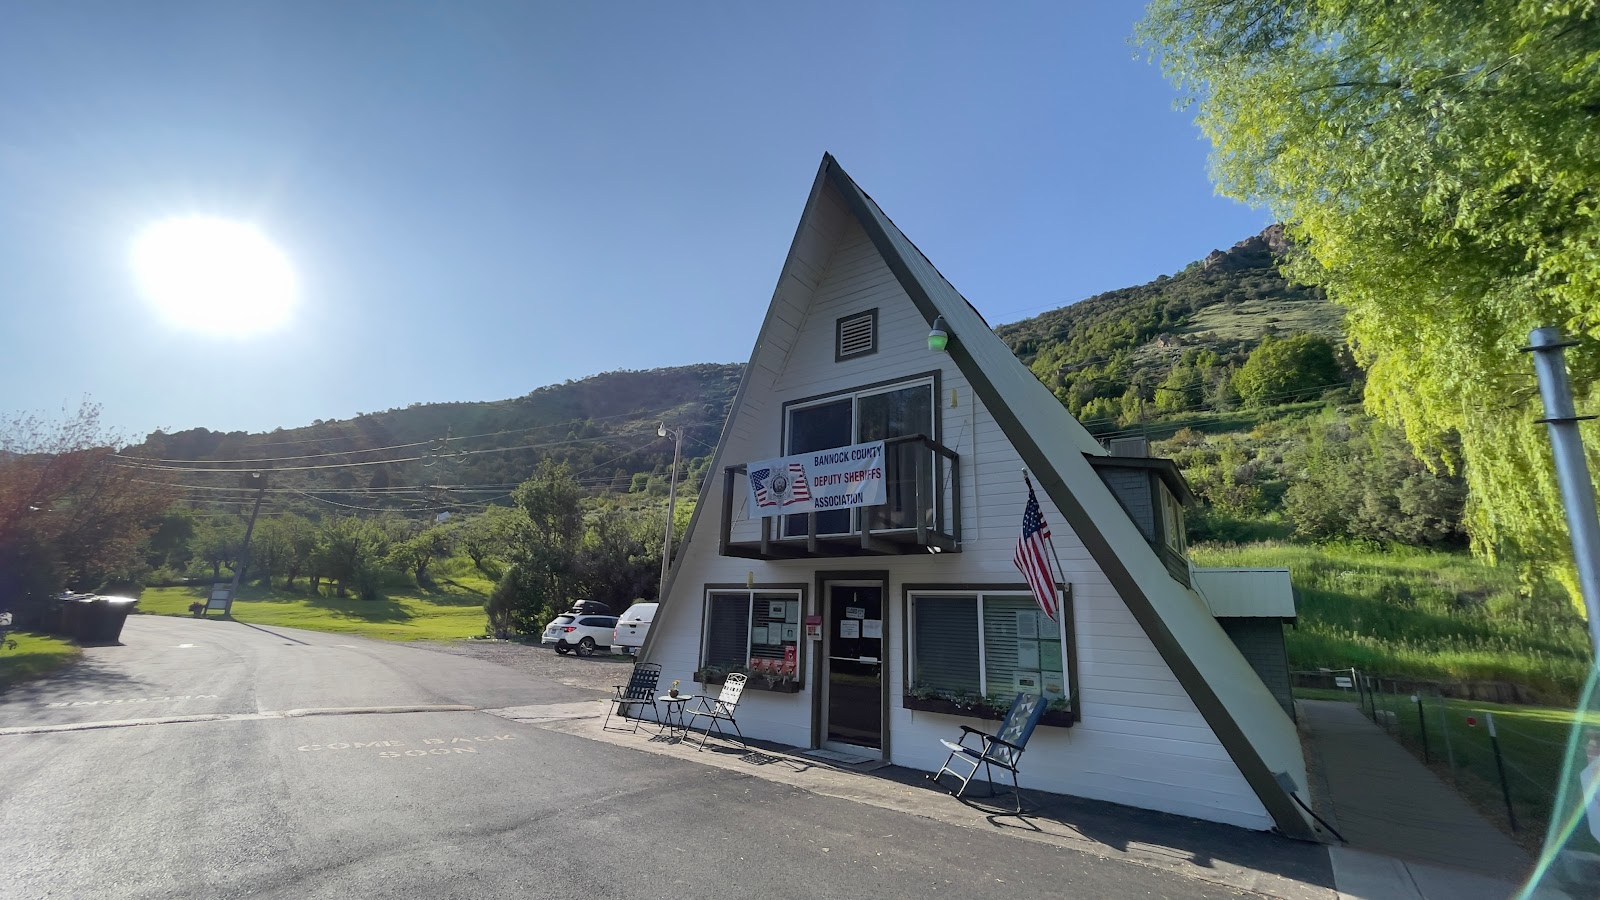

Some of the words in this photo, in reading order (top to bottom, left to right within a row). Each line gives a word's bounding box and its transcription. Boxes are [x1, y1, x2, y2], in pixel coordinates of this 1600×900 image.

[814, 451, 849, 467] BANNOCK
[851, 445, 882, 461] COUNTY
[814, 473, 842, 487] DEPUTY
[844, 467, 882, 483] SHERIFFS
[814, 492, 863, 508] ASSOCIATION
[45, 694, 218, 708] WELCOME
[297, 740, 405, 752] COME
[422, 734, 516, 745] BACK
[379, 747, 477, 758] SOON
